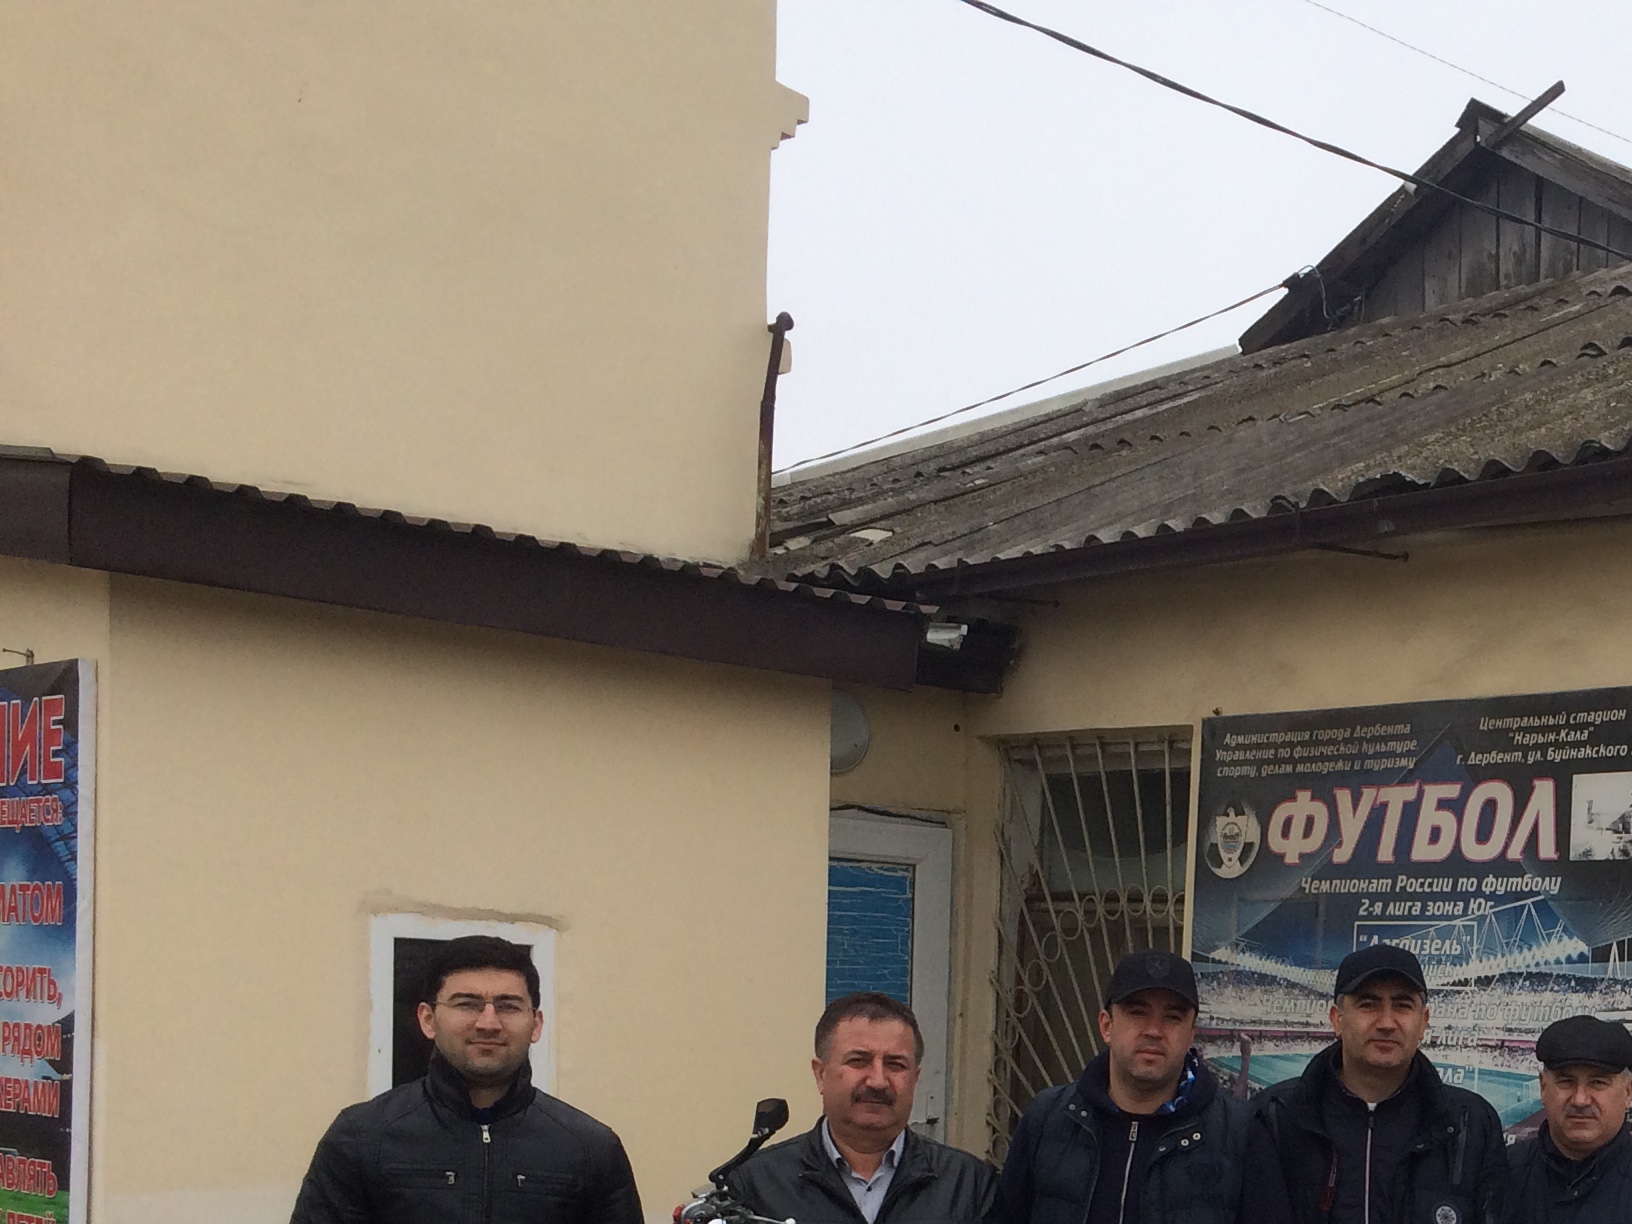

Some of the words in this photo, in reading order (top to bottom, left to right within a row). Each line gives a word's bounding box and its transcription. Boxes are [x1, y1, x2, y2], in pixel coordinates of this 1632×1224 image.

[1479, 711, 1567, 730] Центральный
[1569, 709, 1627, 725] стадион
[1224, 729, 1310, 746] Администрация
[1312, 728, 1351, 743] города
[1353, 723, 1411, 739] Дербента
[1215, 746, 1275, 763] Управление
[1277, 748, 1290, 760] по
[1293, 741, 1359, 759] физической
[1456, 754, 1465, 766] г.
[1527, 750, 1544, 765] ул.
[1546, 743, 1628, 763] Буйнакского
[1261, 763, 1293, 777] делам
[1296, 760, 1352, 774] молодежи
[1354, 760, 1361, 770] и
[1363, 755, 1416, 770] туризму
[1266, 777, 1561, 867] ФУТБОЛ
[1300, 876, 1392, 894] Чемпионат
[1395, 874, 1454, 893] России
[1457, 877, 1476, 893] по
[1481, 874, 1562, 895] футболу
[1358, 898, 1383, 916] 2-я
[1386, 900, 1421, 916] лига
[1426, 900, 1463, 915] зона
[1467, 898, 1494, 916] Юг
[2, 1020, 62, 1066] РЯДОМ
